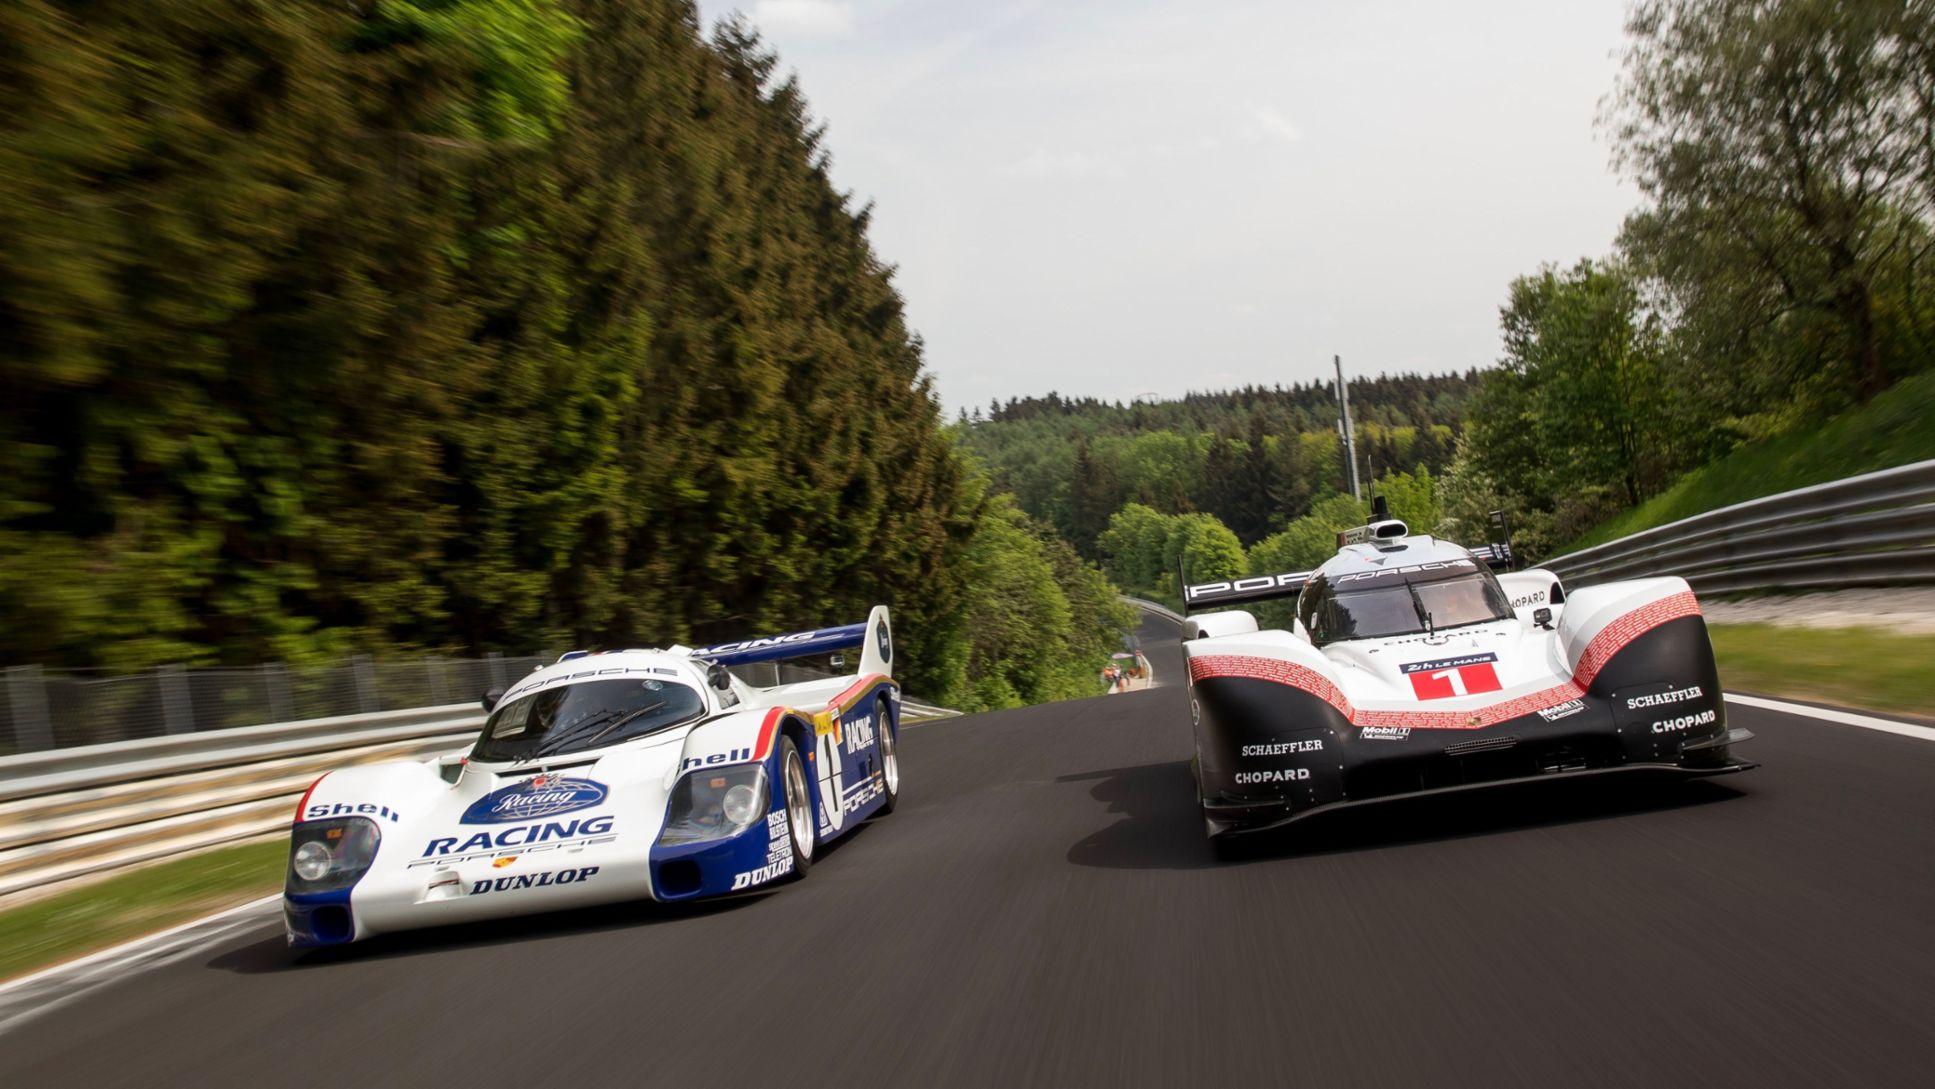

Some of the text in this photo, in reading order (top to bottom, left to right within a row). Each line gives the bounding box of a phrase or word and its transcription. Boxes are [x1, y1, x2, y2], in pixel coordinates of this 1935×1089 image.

[1337, 559, 1477, 584] PORSCHE
[691, 631, 816, 656] ACING
[1453, 656, 1491, 666] MANS
[502, 667, 679, 702] PORSCHE
[1432, 668, 1469, 697] 1
[1626, 686, 1703, 710] SCHAEFFLER
[1361, 726, 1398, 735] Mobil
[1652, 710, 1716, 734] CHOPARD
[845, 716, 874, 754] RACING
[682, 748, 750, 771] hell
[1242, 739, 1323, 757] SCHAEFFLER
[1235, 768, 1311, 784] CHOPARD
[308, 803, 399, 823] Shell
[492, 789, 577, 813] Racing
[422, 815, 615, 857] RACING
[407, 836, 617, 870] PORSCHE
[469, 866, 600, 896] DUNLOP
[731, 855, 794, 891] DUNLOP
